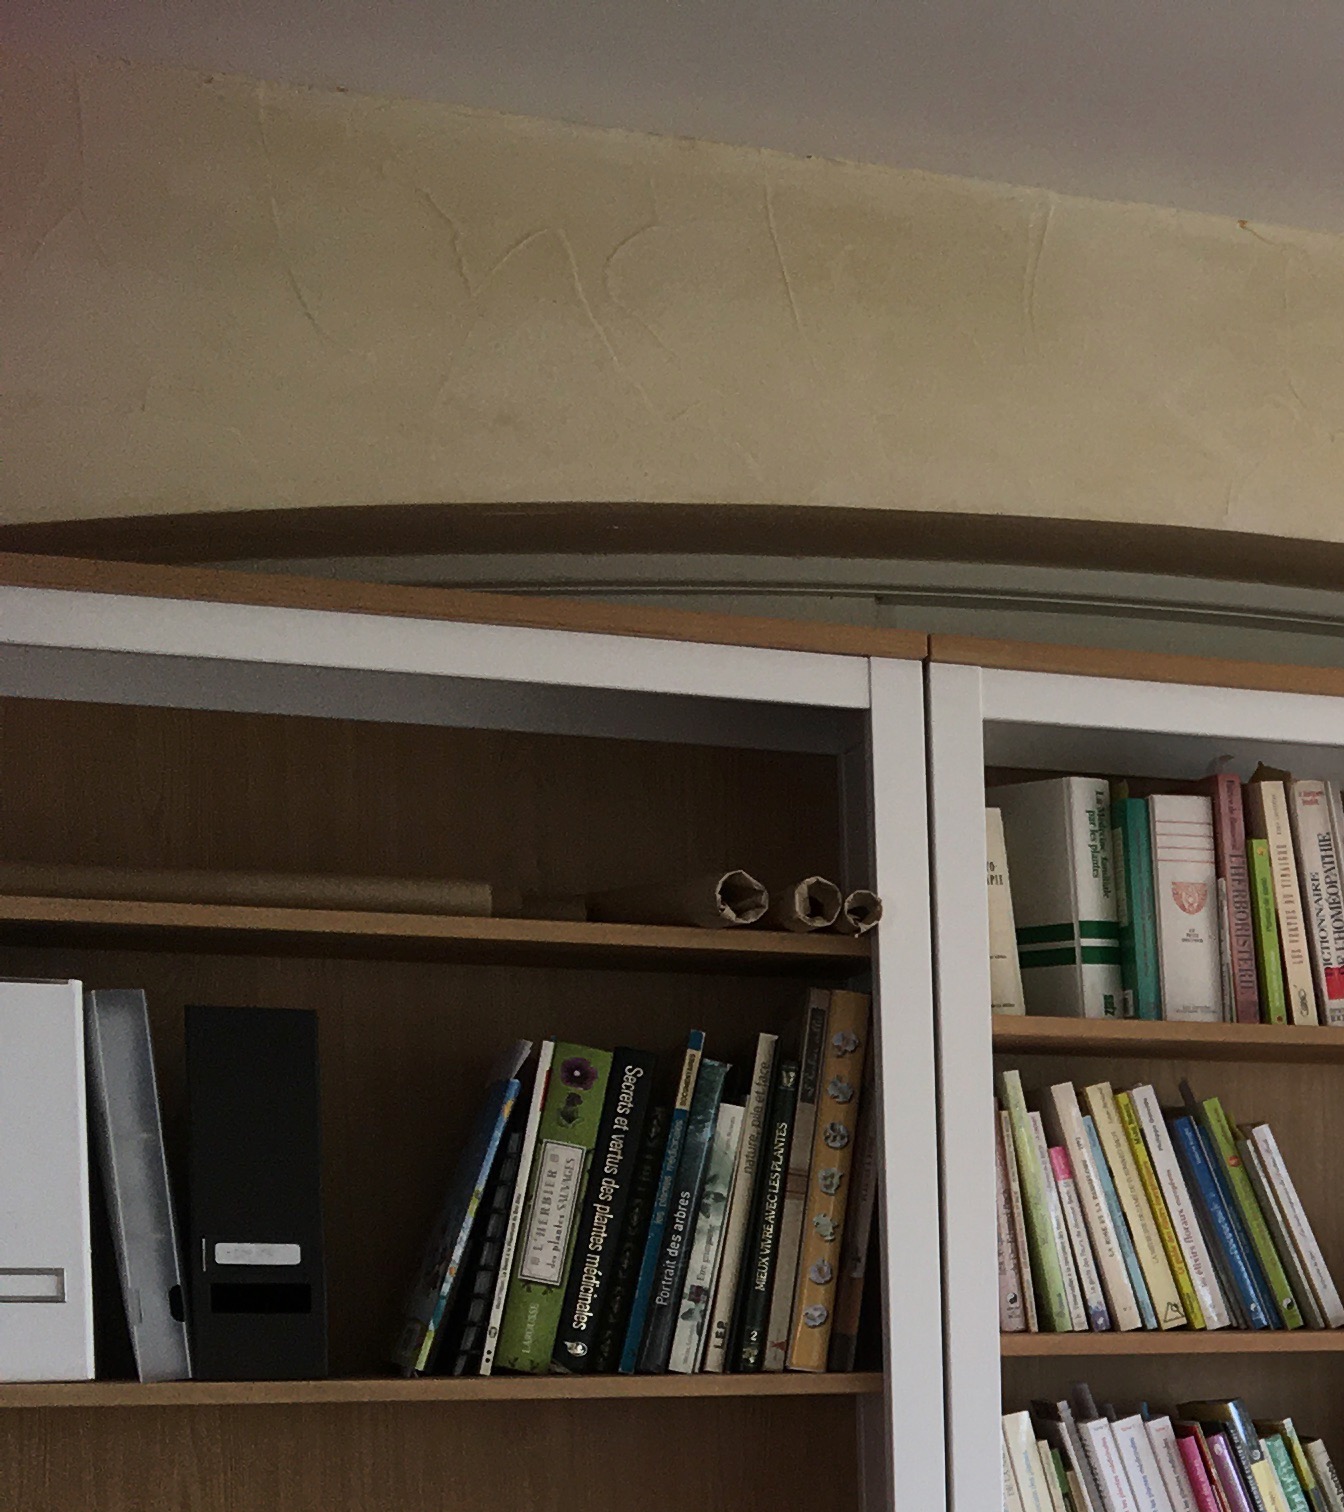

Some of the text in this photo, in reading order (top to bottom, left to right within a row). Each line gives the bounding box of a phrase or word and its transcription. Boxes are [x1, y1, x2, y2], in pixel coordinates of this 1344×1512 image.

[1089, 828, 1099, 842] les
[1088, 843, 1102, 878] plantes
[740, 1060, 771, 1176] nature, pile et face
[531, 1168, 559, 1252] L'HERBIER
[568, 1063, 644, 1332] Secrets et vertus des plantes médicinales
[754, 1120, 788, 1291] MIEUX VIVRE AVEC LES PLANTES
[545, 1212, 567, 1253] plantes
[1175, 1207, 1194, 1245] floraux
[545, 1253, 557, 1269] des
[652, 1188, 693, 1307] Portrait des arbres
[1323, 1458, 1344, 1496] herbes
